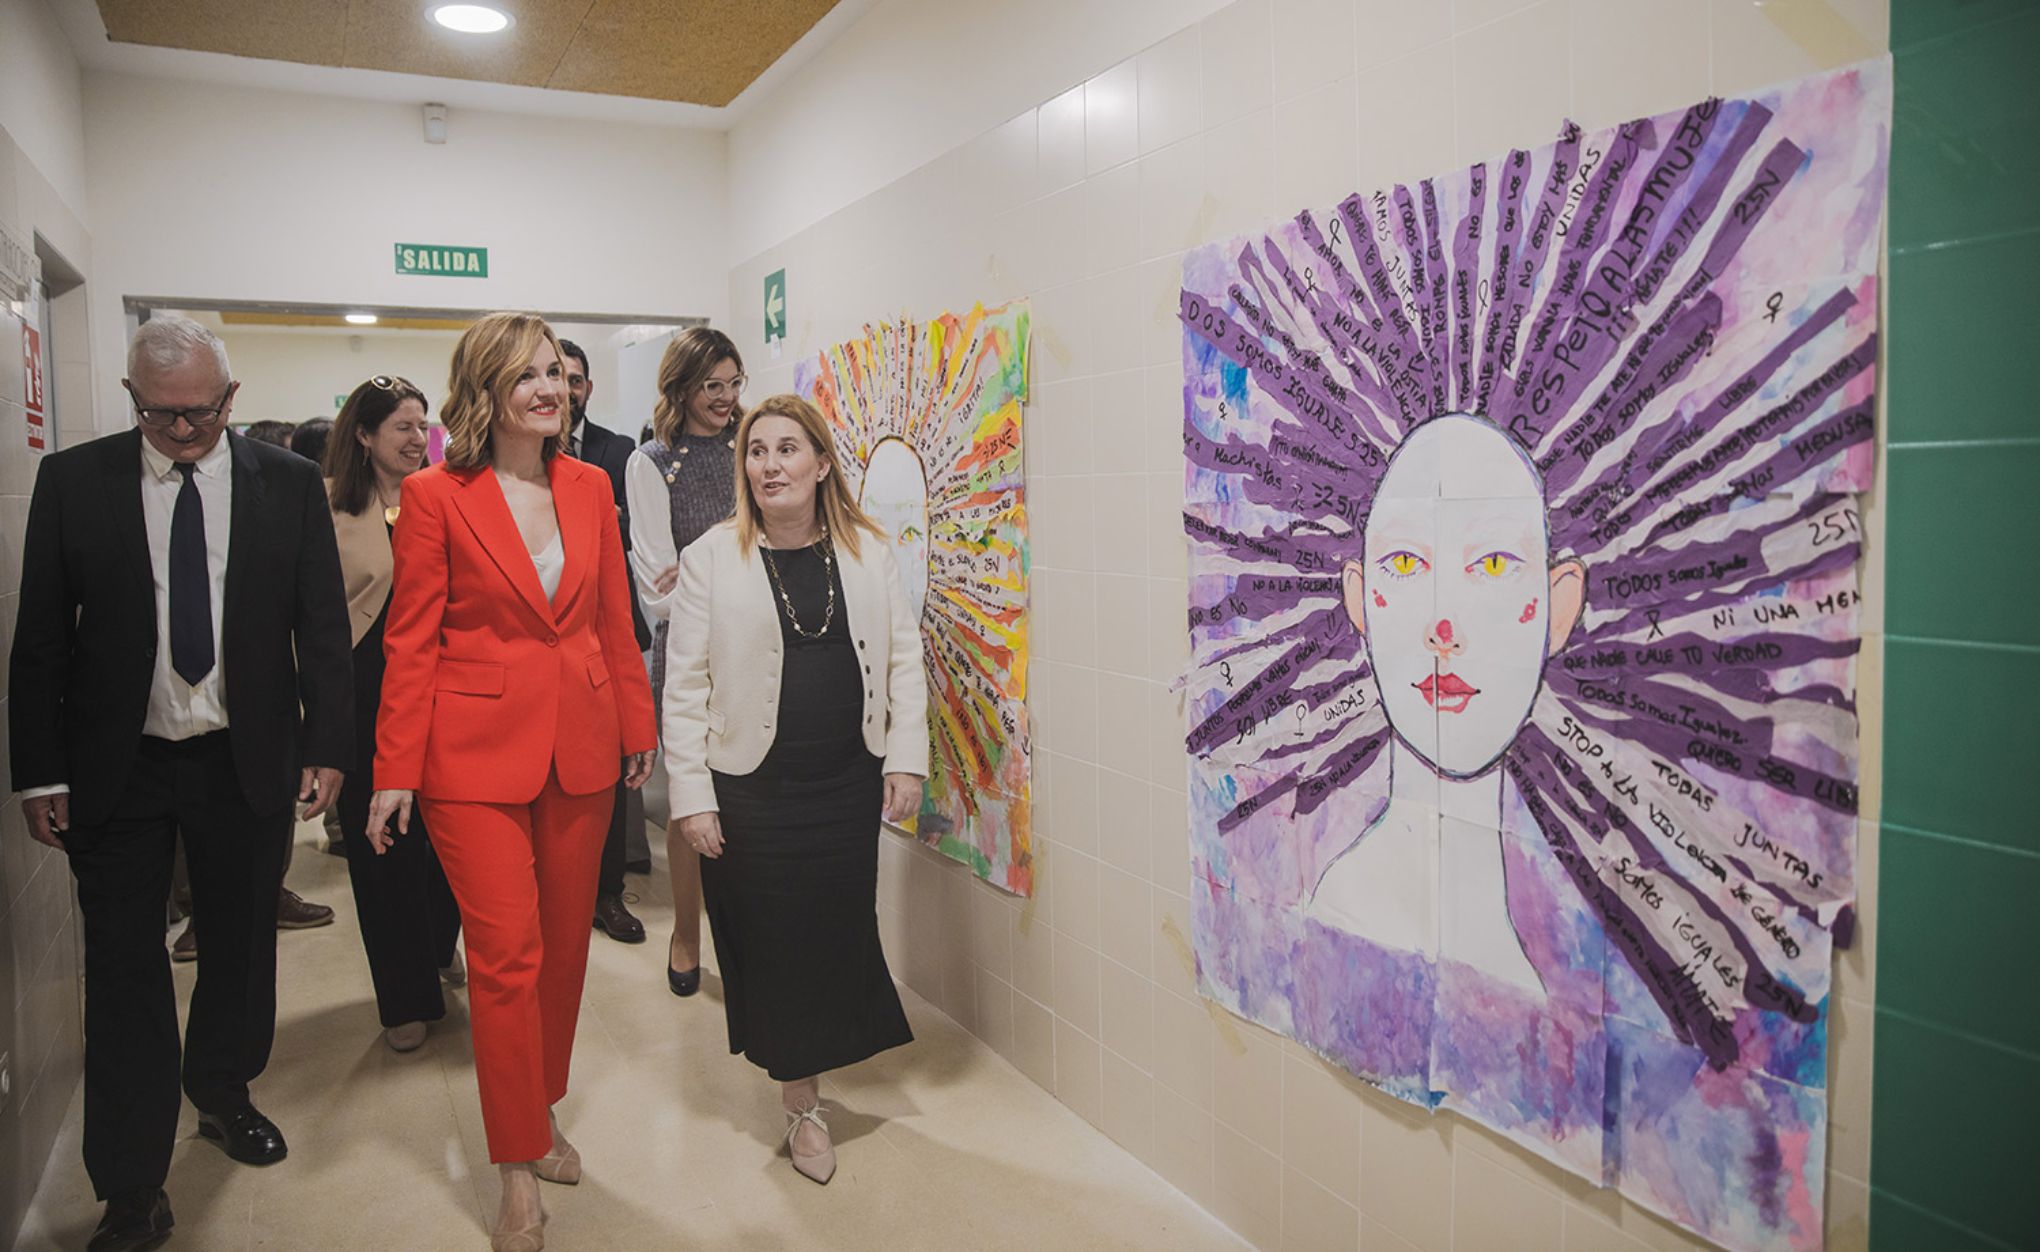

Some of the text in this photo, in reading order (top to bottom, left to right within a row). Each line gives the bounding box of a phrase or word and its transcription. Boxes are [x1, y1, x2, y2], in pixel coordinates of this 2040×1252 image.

[1733, 169, 1781, 226] 25N
[1468, 215, 1480, 239] NO
[403, 248, 480, 272] SALIDA
[1399, 198, 1418, 246] TODOS
[1411, 249, 1426, 294] SOMOS
[1518, 260, 1534, 288] NO
[1187, 300, 1227, 338] DOS
[1235, 335, 1283, 380] SOMOS
[1333, 311, 1416, 428] NO A LA VIOLENCIA
[1295, 550, 1324, 569] 25N
[1253, 579, 1266, 590] NO
[1268, 580, 1276, 590] A
[1278, 580, 1293, 591] LA
[1229, 596, 1248, 617] NO
[1753, 605, 1799, 625] UNA
[1557, 716, 1604, 758] STOP
[1600, 760, 1613, 779] A
[1651, 760, 1715, 812] TODAS
[1733, 822, 1824, 889] JUNTAS
[1755, 973, 1801, 1014] 25N
